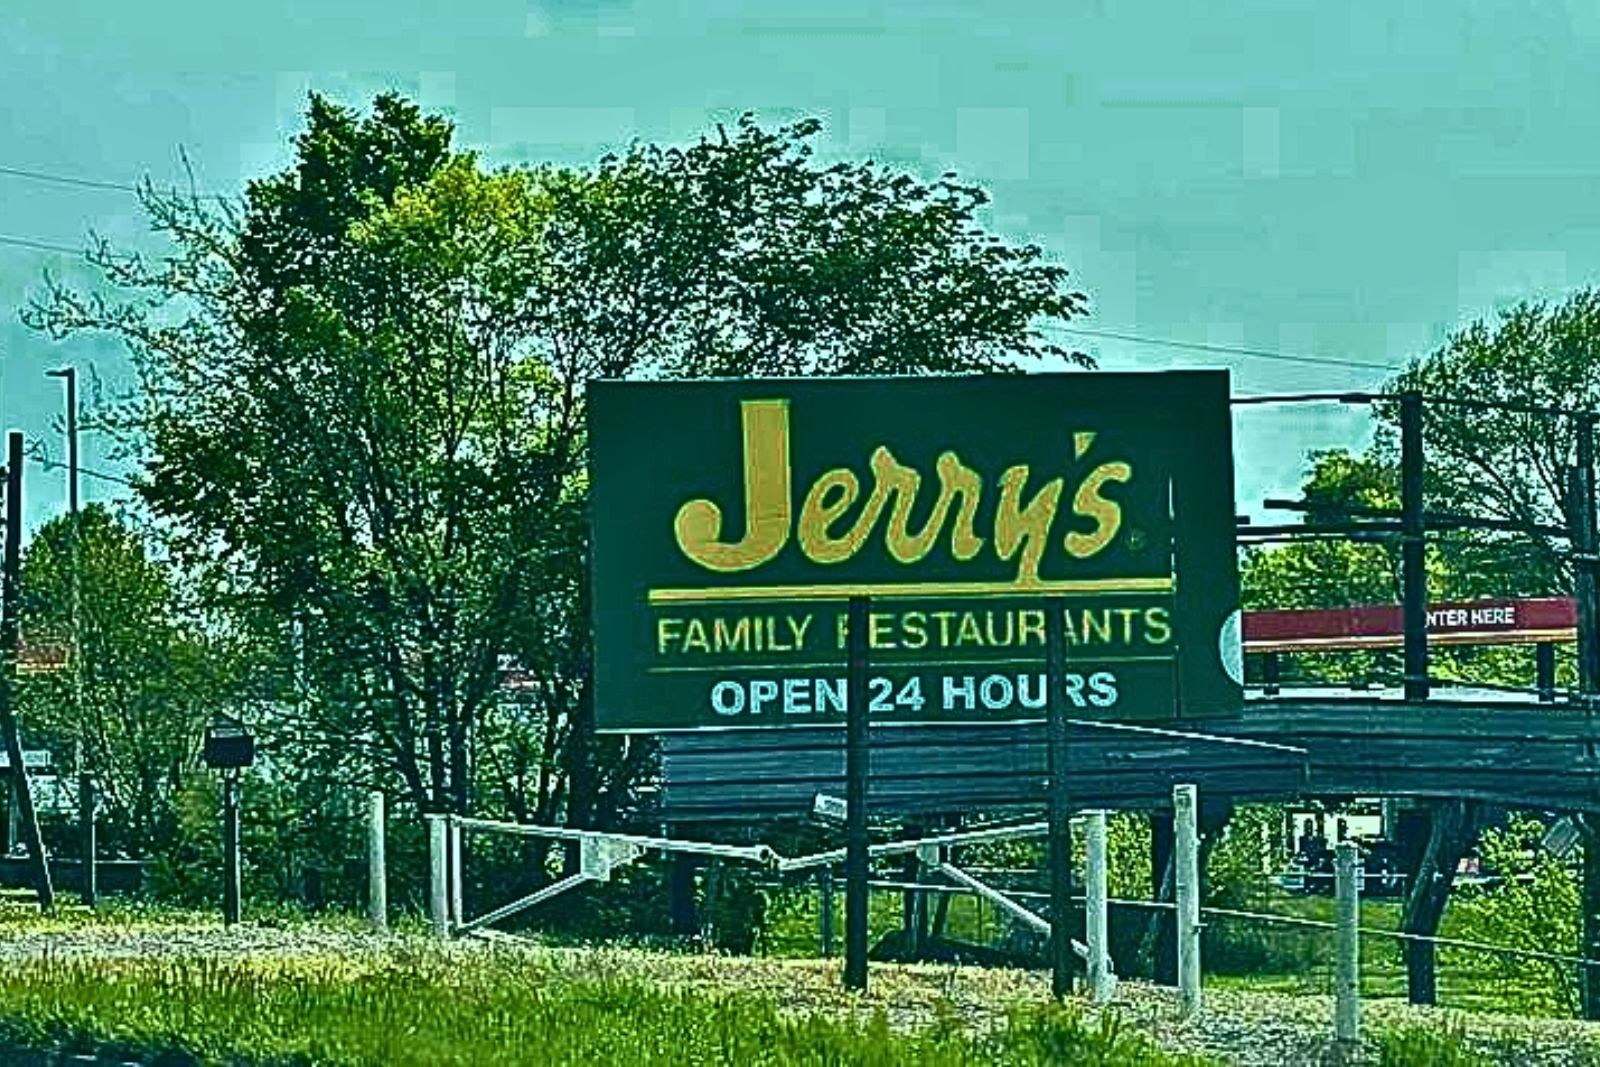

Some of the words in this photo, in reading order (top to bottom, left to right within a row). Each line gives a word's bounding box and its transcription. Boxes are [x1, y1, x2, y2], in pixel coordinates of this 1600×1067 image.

[674, 399, 1132, 586] Jerry's
[657, 613, 813, 653] FAMILY
[1426, 609, 1468, 626] NTER
[1471, 607, 1515, 624] HERE
[711, 678, 848, 716] OPEN
[868, 675, 925, 713] 24
[942, 671, 1118, 710] HOURS
